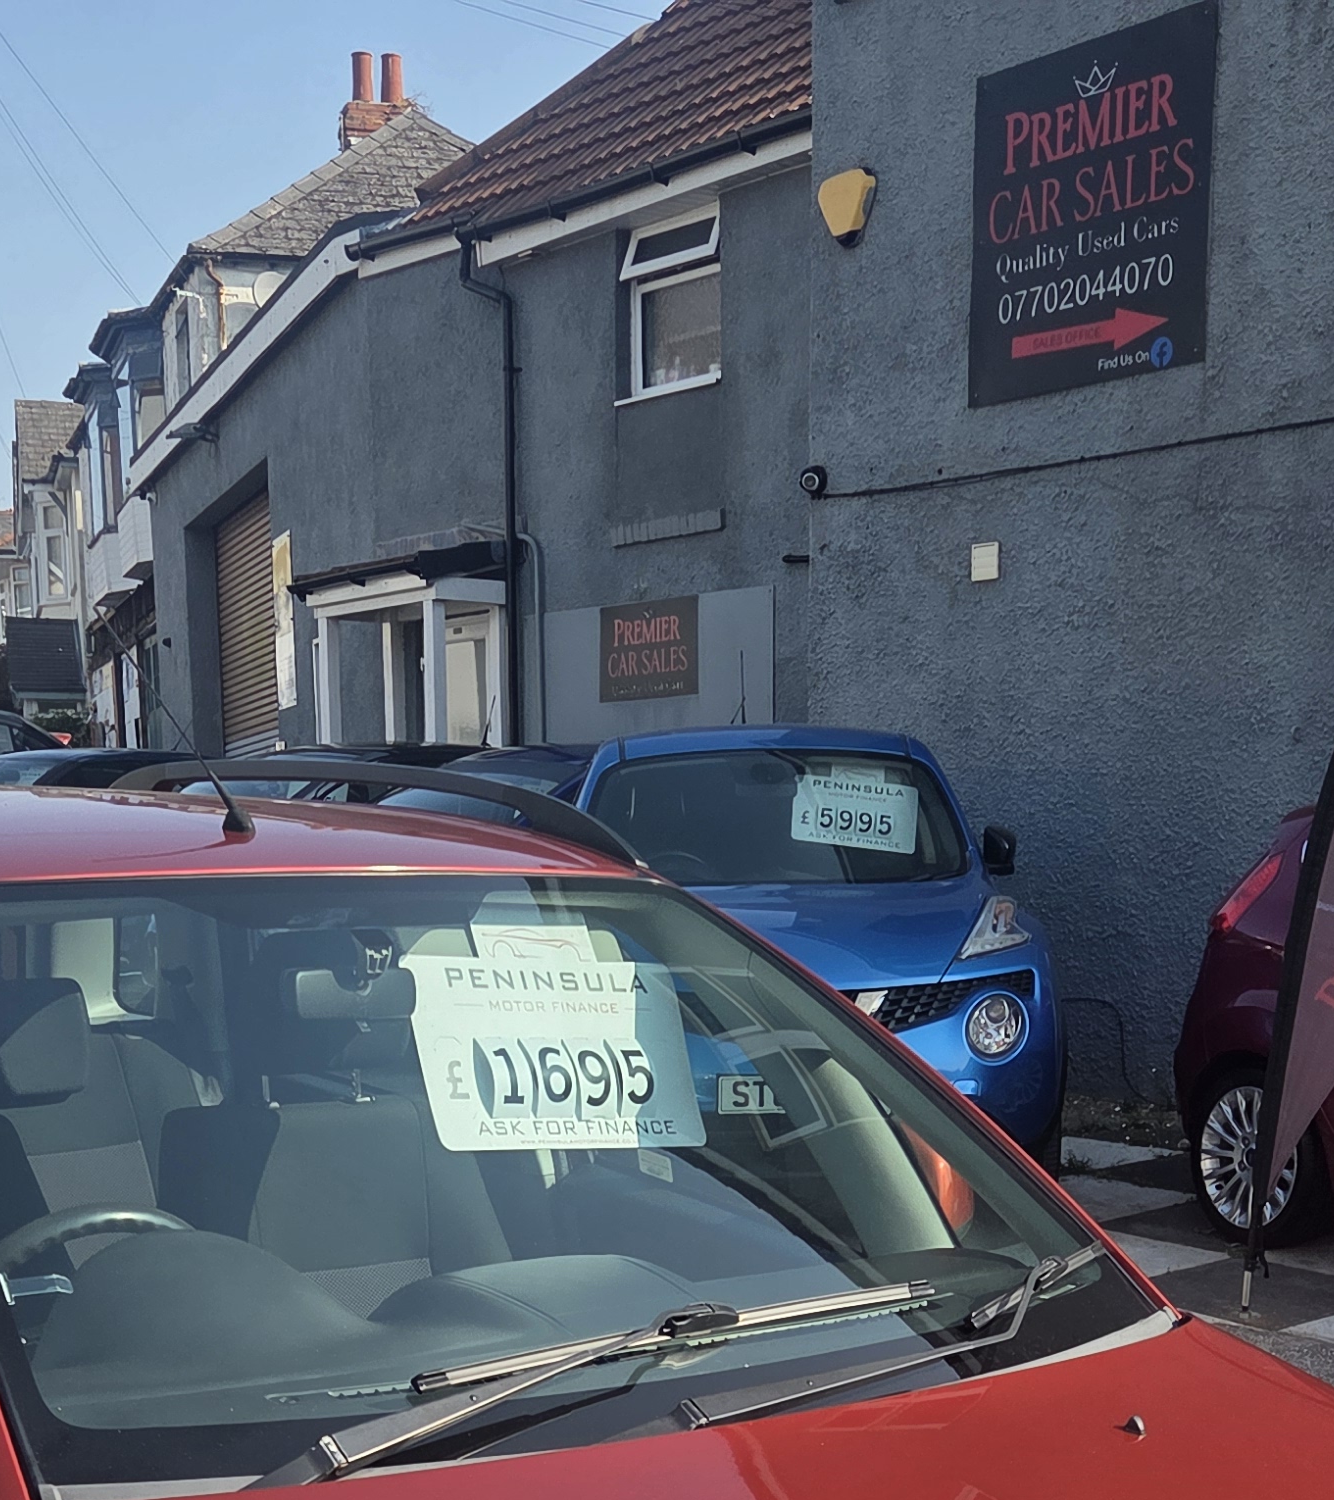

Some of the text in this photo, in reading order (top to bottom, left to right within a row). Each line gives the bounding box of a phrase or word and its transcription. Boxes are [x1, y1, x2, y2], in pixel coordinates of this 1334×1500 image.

[1003, 73, 1178, 176] PREMIER
[989, 138, 1195, 244] CAR SALES
[996, 216, 1180, 283] Quality Used Cars
[998, 253, 1174, 325] 07702044070
[1098, 350, 1150, 371] Find Us On
[613, 615, 681, 647] PREMIER
[608, 645, 688, 677] CAR SALES
[812, 779, 905, 798] PENINSULA
[819, 807, 892, 836] 5995
[444, 966, 649, 995] PENINSULA
[488, 1000, 620, 1015] MOTOR FINANCE
[446, 1046, 655, 1107] £ 1695
[479, 1119, 678, 1136] ASK FOR FINANCE
